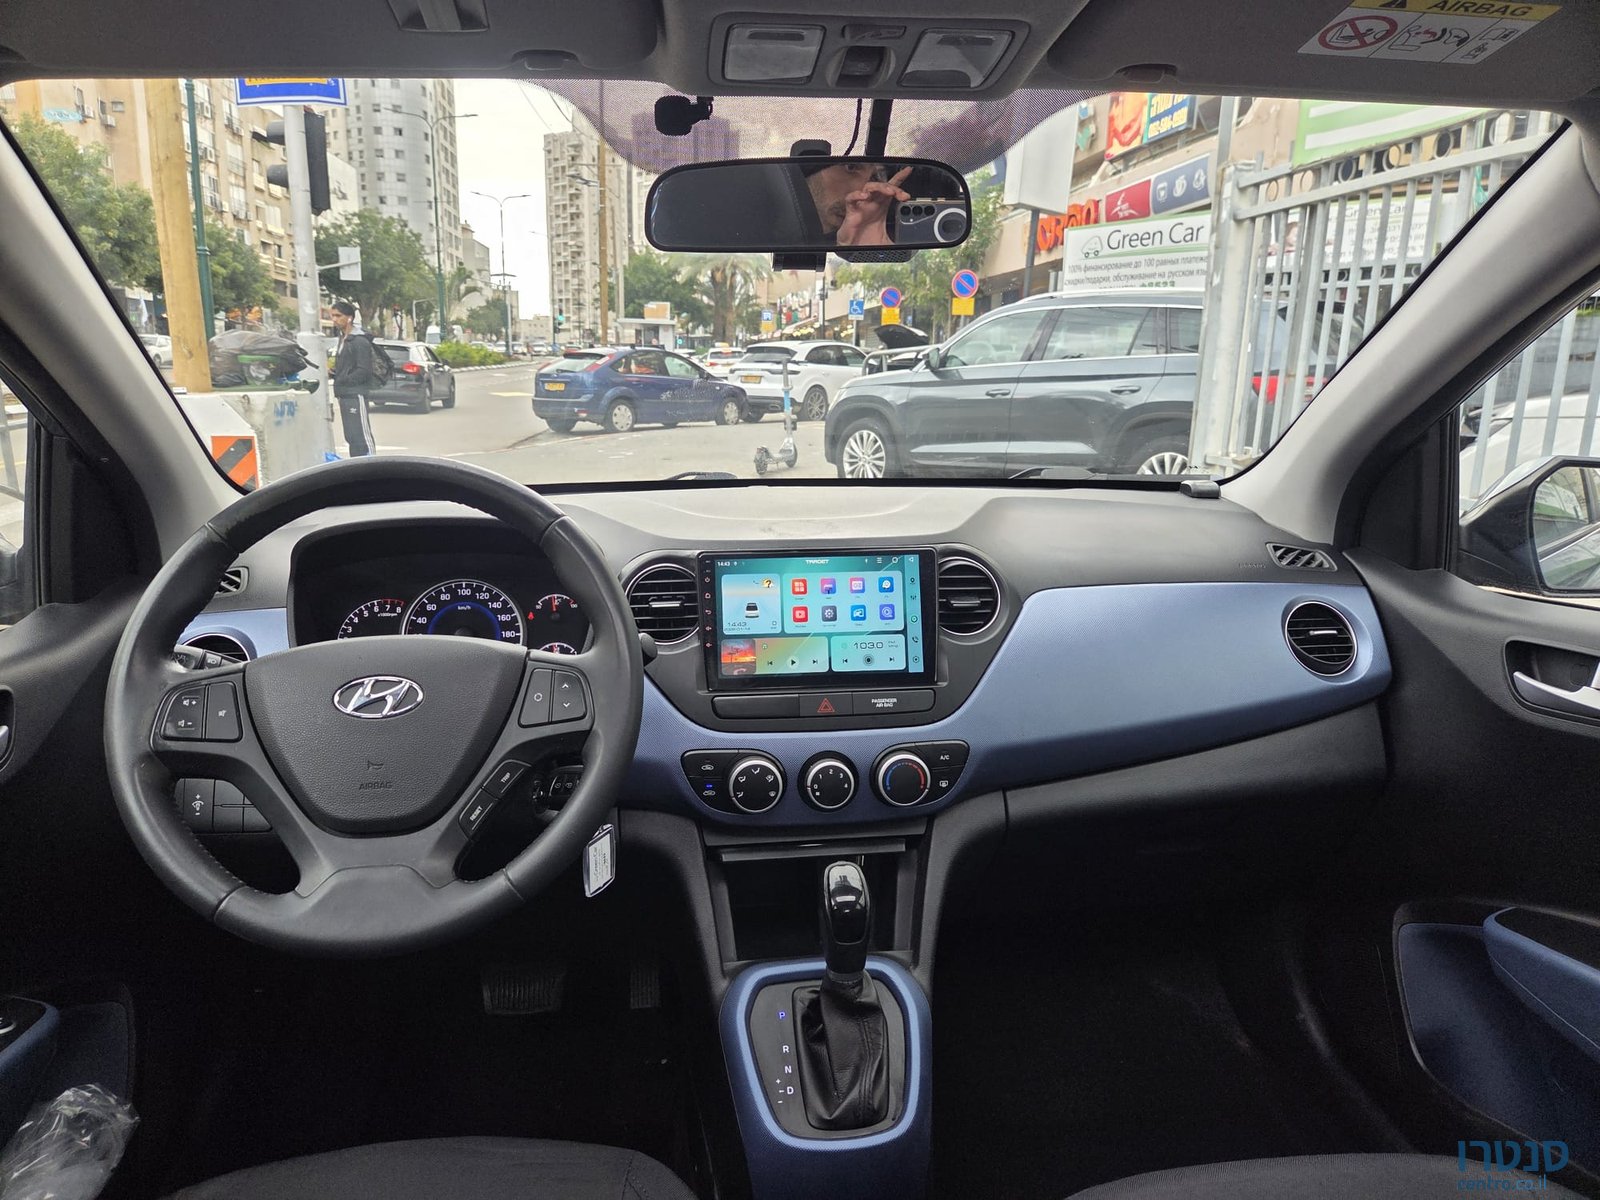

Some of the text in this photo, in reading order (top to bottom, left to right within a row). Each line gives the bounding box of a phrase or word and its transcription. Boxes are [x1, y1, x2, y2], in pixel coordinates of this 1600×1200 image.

[1428, 0, 1532, 17] AIRBAG
[1345, 206, 1382, 218] Gren
[1107, 222, 1205, 250] Green Car
[1143, 258, 1155, 268] 100
[1167, 269, 1195, 280] русском
[456, 588, 472, 596] 100
[475, 592, 490, 600] 120
[440, 593, 450, 601] 80
[373, 605, 379, 613] 6
[385, 604, 391, 612] 7
[426, 603, 437, 611] 60
[488, 601, 502, 609] 140
[363, 610, 369, 618] 5
[396, 606, 402, 614] 8
[416, 616, 428, 624] 40
[497, 613, 511, 621] 160
[347, 626, 353, 634] 3
[501, 630, 516, 638] 180
[358, 781, 393, 791] AIRBAG
[470, 806, 483, 821] RESET
[779, 1011, 785, 1019] P
[782, 1045, 790, 1053] R
[784, 1065, 792, 1074] N
[787, 1086, 794, 1094] D
